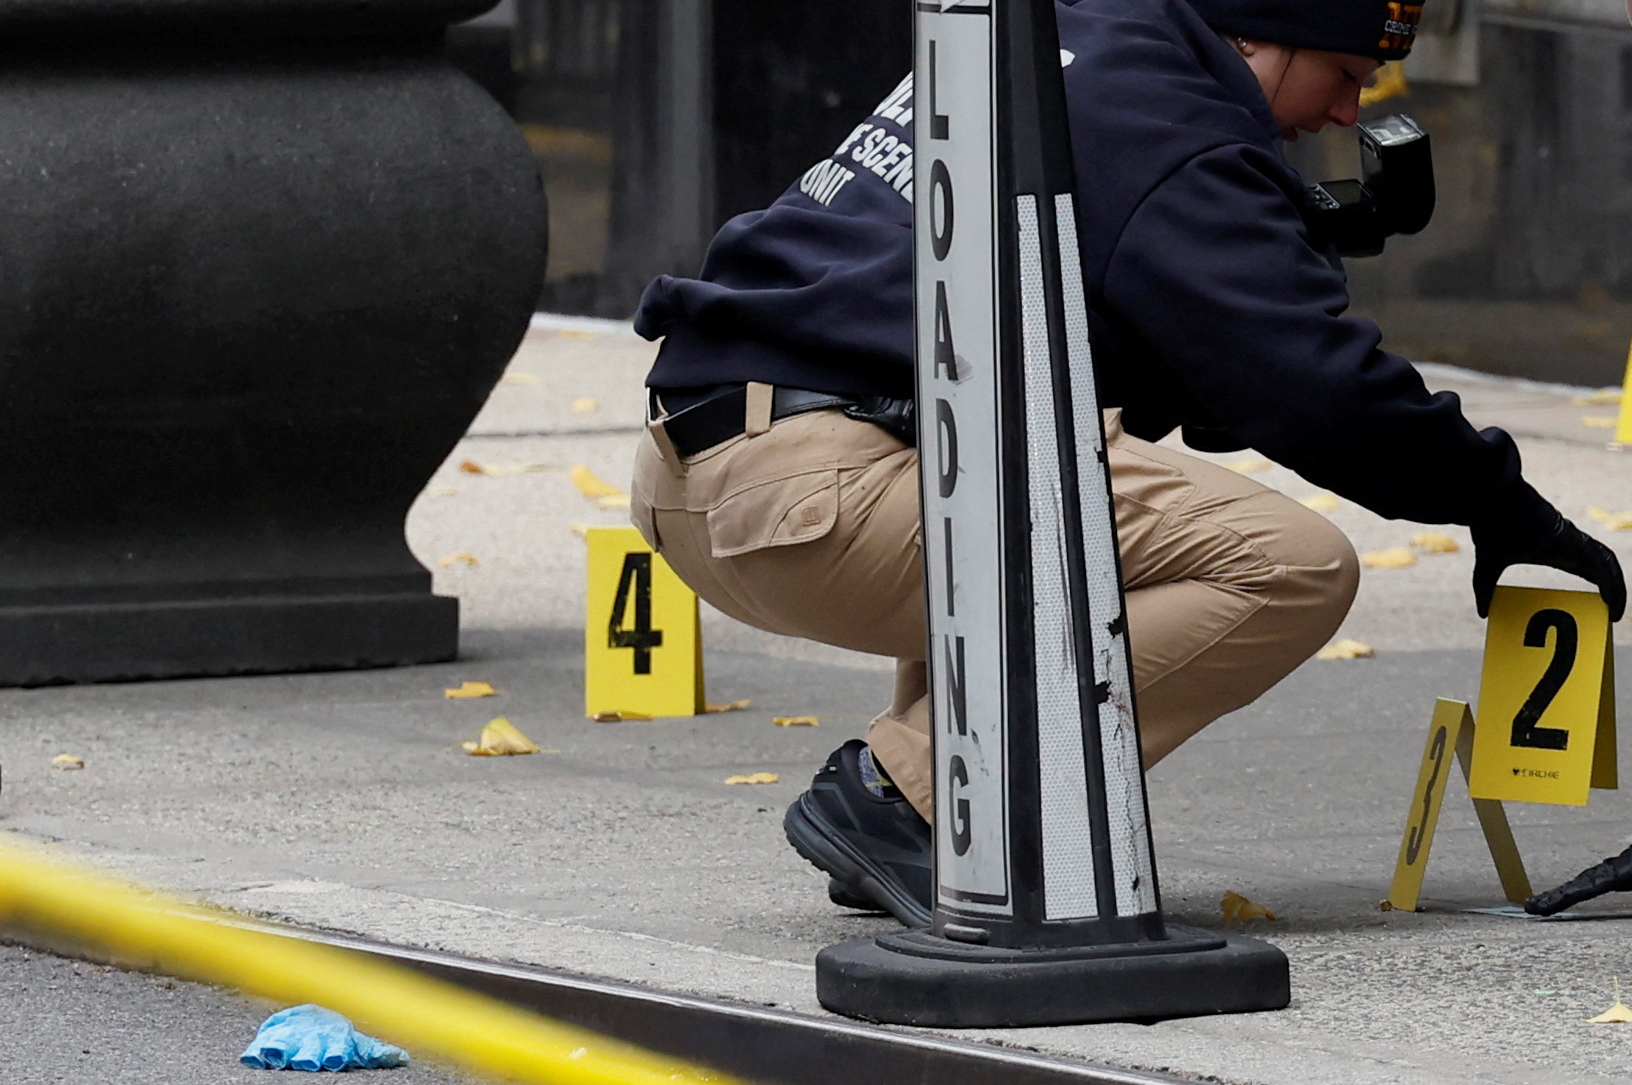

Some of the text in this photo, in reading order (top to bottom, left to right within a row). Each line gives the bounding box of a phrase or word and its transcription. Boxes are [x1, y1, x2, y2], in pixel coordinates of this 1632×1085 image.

[799, 158, 856, 208] UNIT
[851, 127, 913, 205] SCEN
[928, 39, 972, 858] LOADING
[608, 551, 663, 675] 4
[1510, 607, 1579, 752] 2
[1406, 724, 1449, 866] 3
